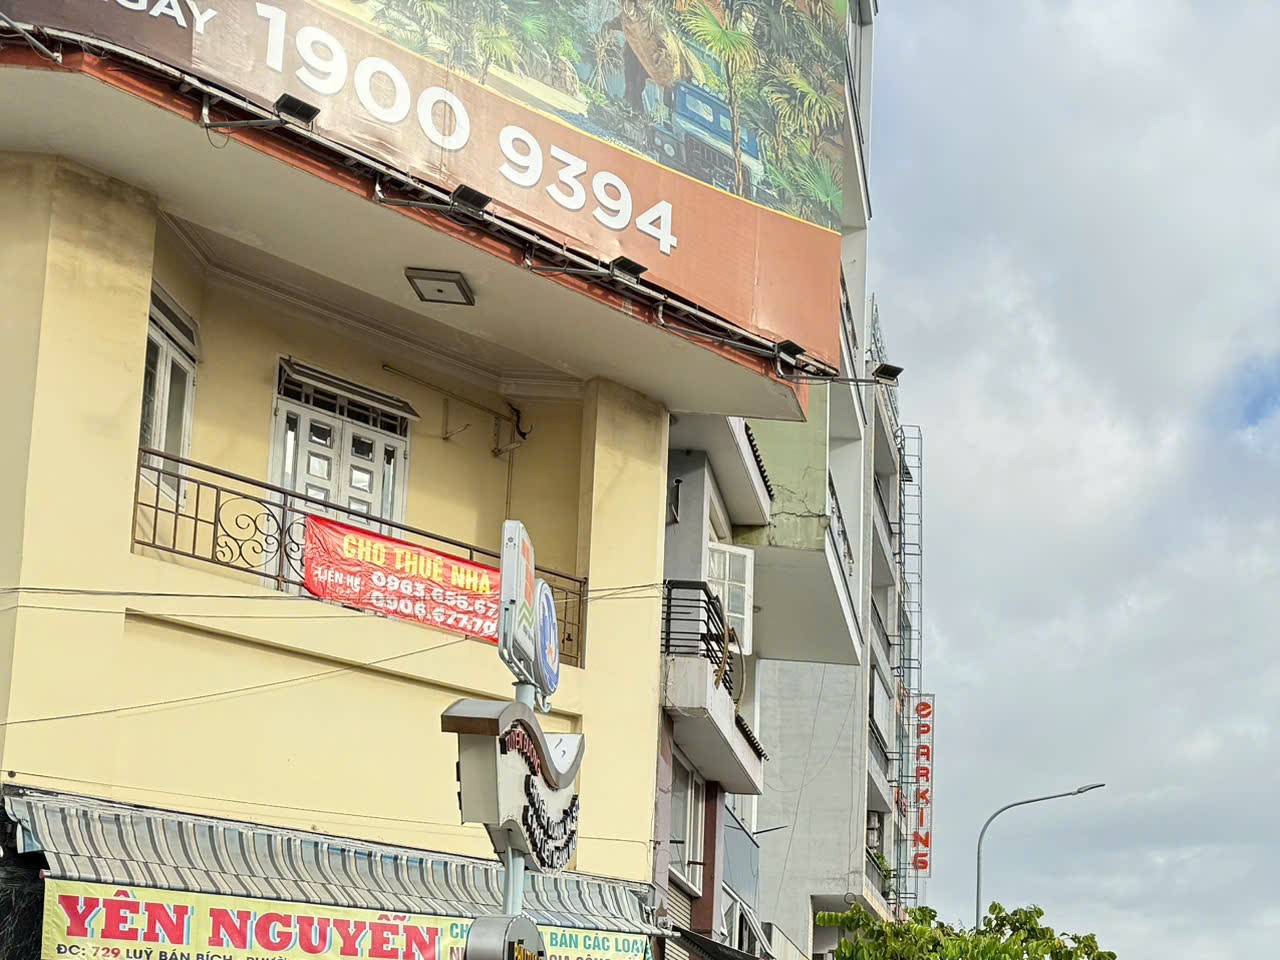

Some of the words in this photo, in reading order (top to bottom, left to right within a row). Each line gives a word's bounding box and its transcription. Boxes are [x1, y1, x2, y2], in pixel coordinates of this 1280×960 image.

[256, 2, 471, 151] 1900
[499, 125, 677, 255] 9394
[343, 535, 386, 567] CHO
[390, 549, 444, 583] THUÊ
[451, 566, 492, 594] NHÀ
[56, 943, 86, 956] ĐC:
[91, 946, 121, 958] 729
[58, 890, 190, 945] YÊN
[550, 929, 579, 948] BÁN
[583, 933, 610, 951] CÁC
